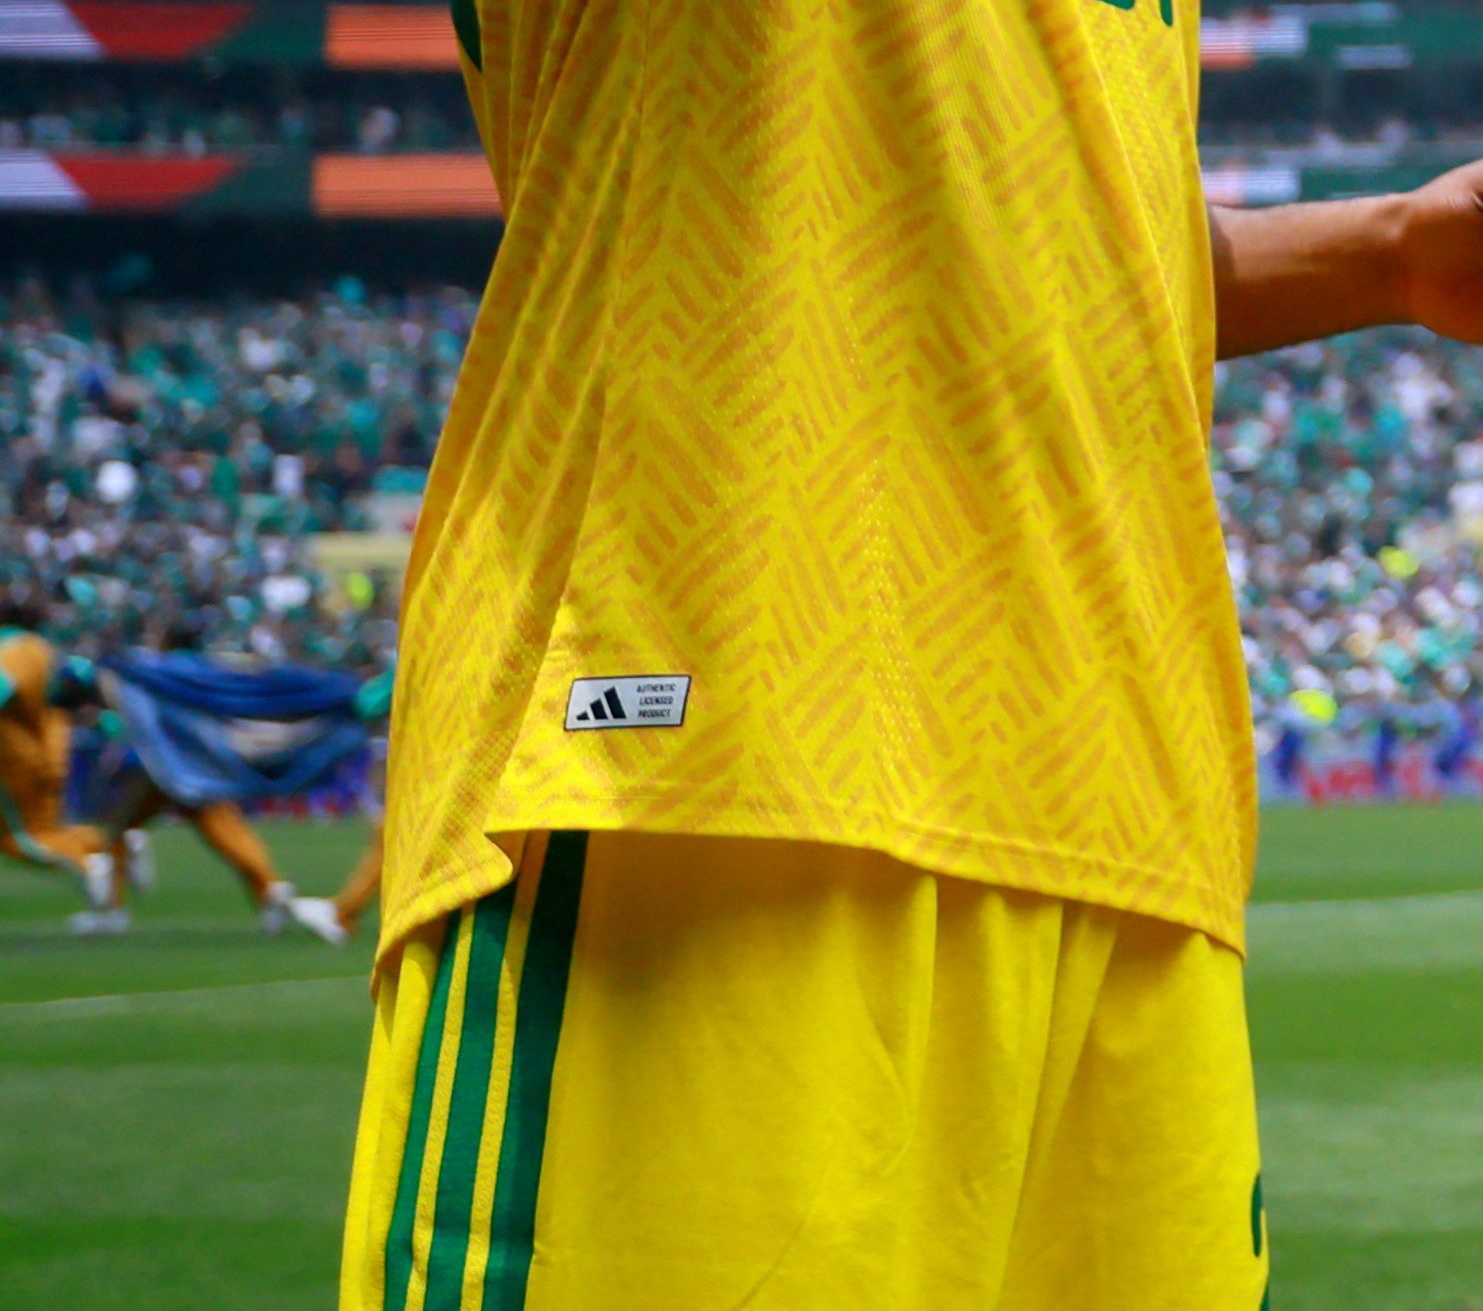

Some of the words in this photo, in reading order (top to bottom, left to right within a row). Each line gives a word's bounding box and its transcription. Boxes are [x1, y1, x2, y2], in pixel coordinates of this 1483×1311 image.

[637, 683, 676, 693] AUTHENTIC
[639, 695, 674, 706] LICENSED
[637, 708, 671, 719] PRODUCT
